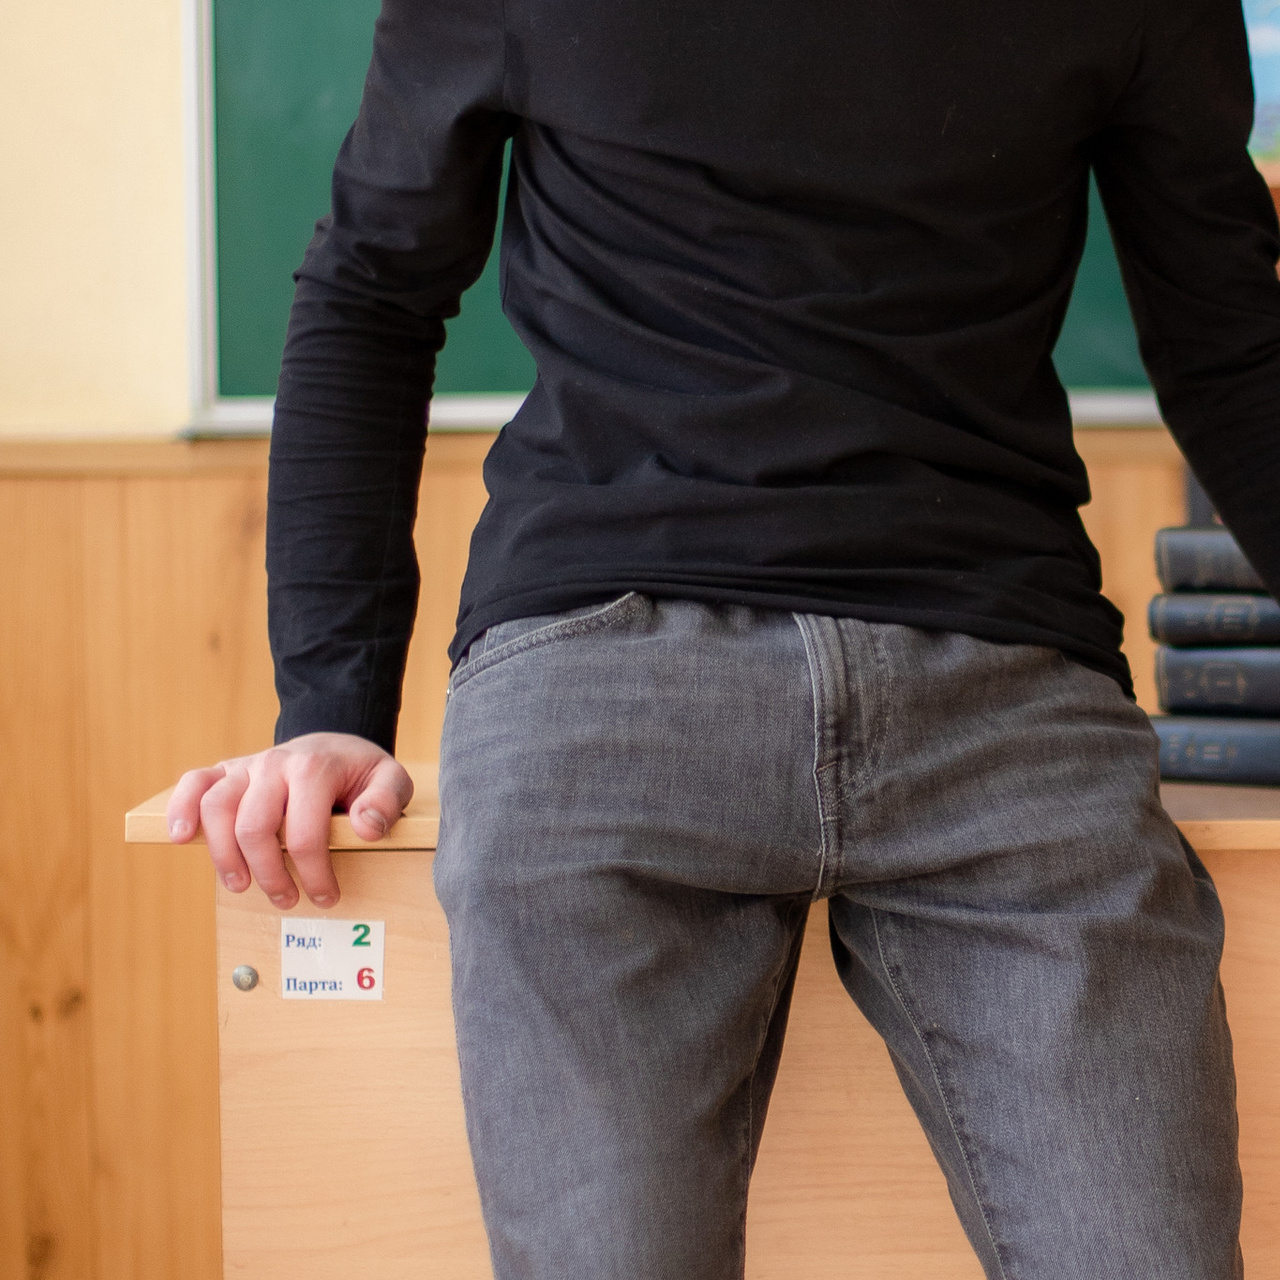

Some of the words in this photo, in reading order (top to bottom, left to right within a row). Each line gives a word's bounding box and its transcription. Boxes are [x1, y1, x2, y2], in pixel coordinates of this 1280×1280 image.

[285, 933, 323, 951] Ряд:
[352, 923, 371, 947] 2
[286, 977, 343, 995] Парта:
[356, 967, 376, 991] 6
